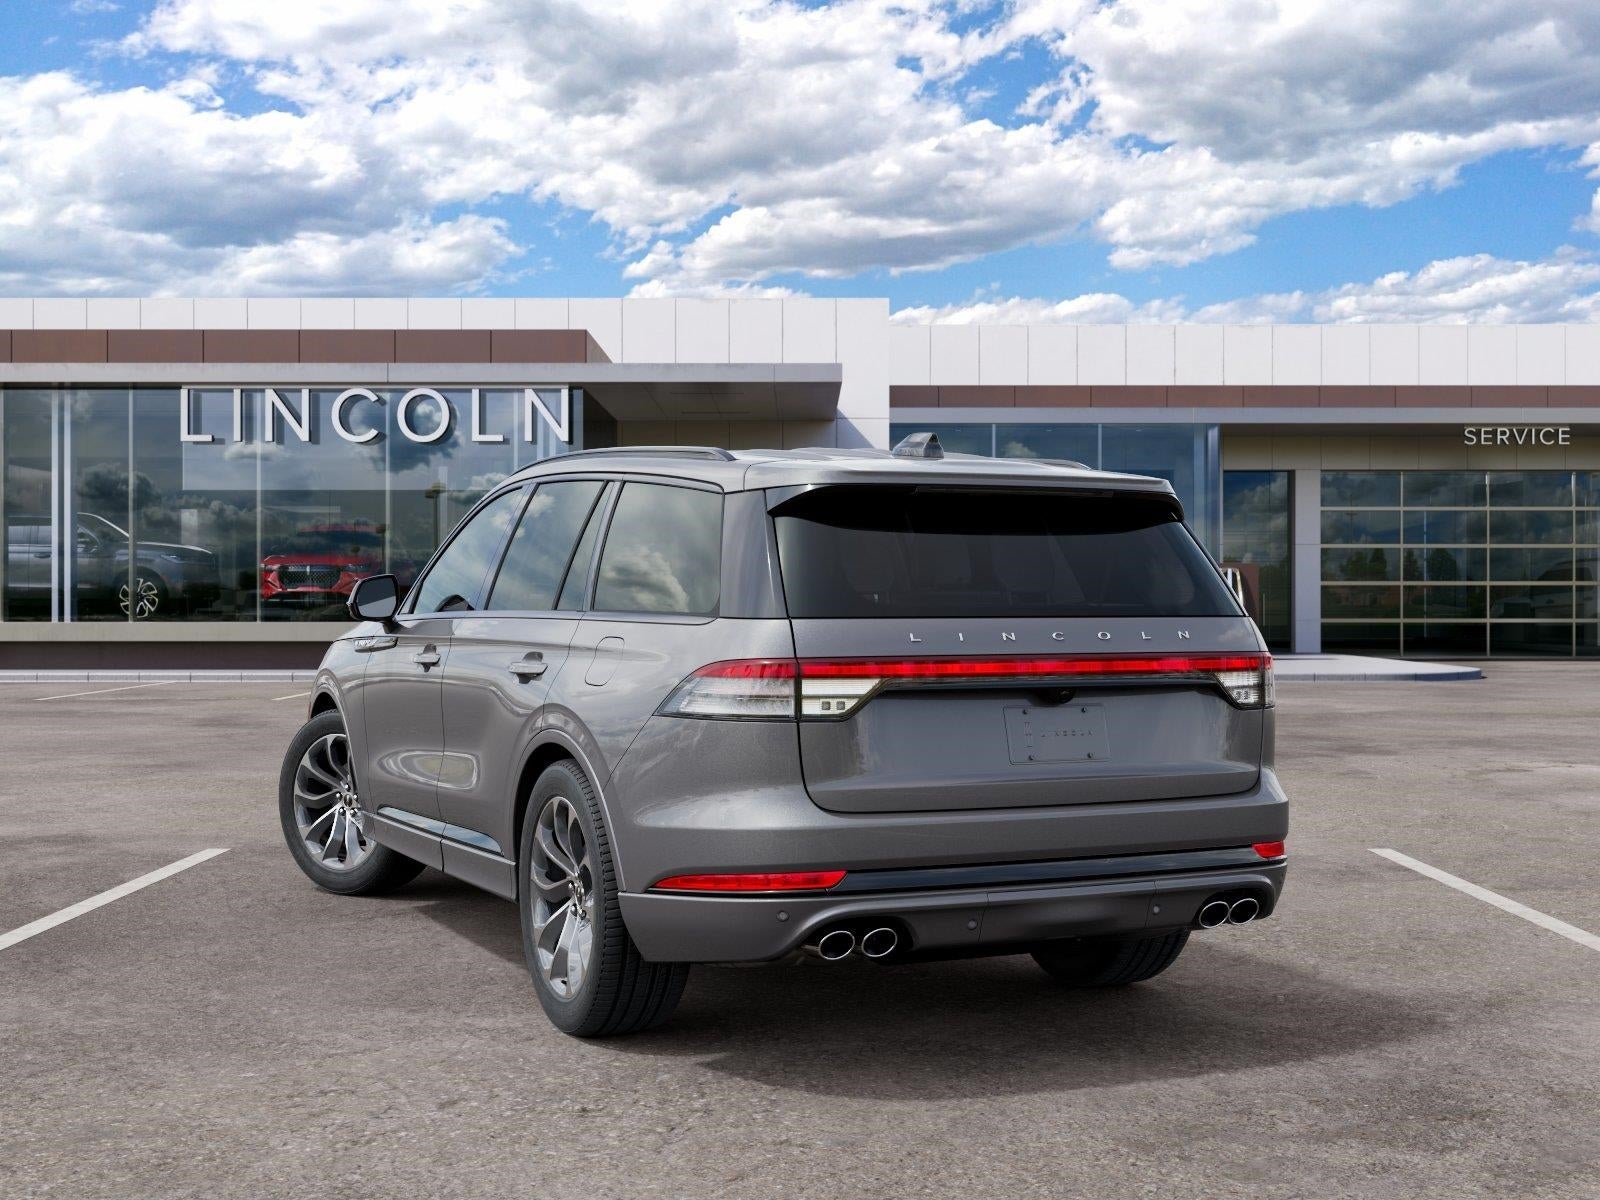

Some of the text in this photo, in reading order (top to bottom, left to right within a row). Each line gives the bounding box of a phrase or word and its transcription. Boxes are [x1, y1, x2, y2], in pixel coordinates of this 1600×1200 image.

[180, 387, 570, 443] LINCOLN
[1464, 427, 1571, 445] SERVICE
[908, 630, 1191, 642] LINCOLN
